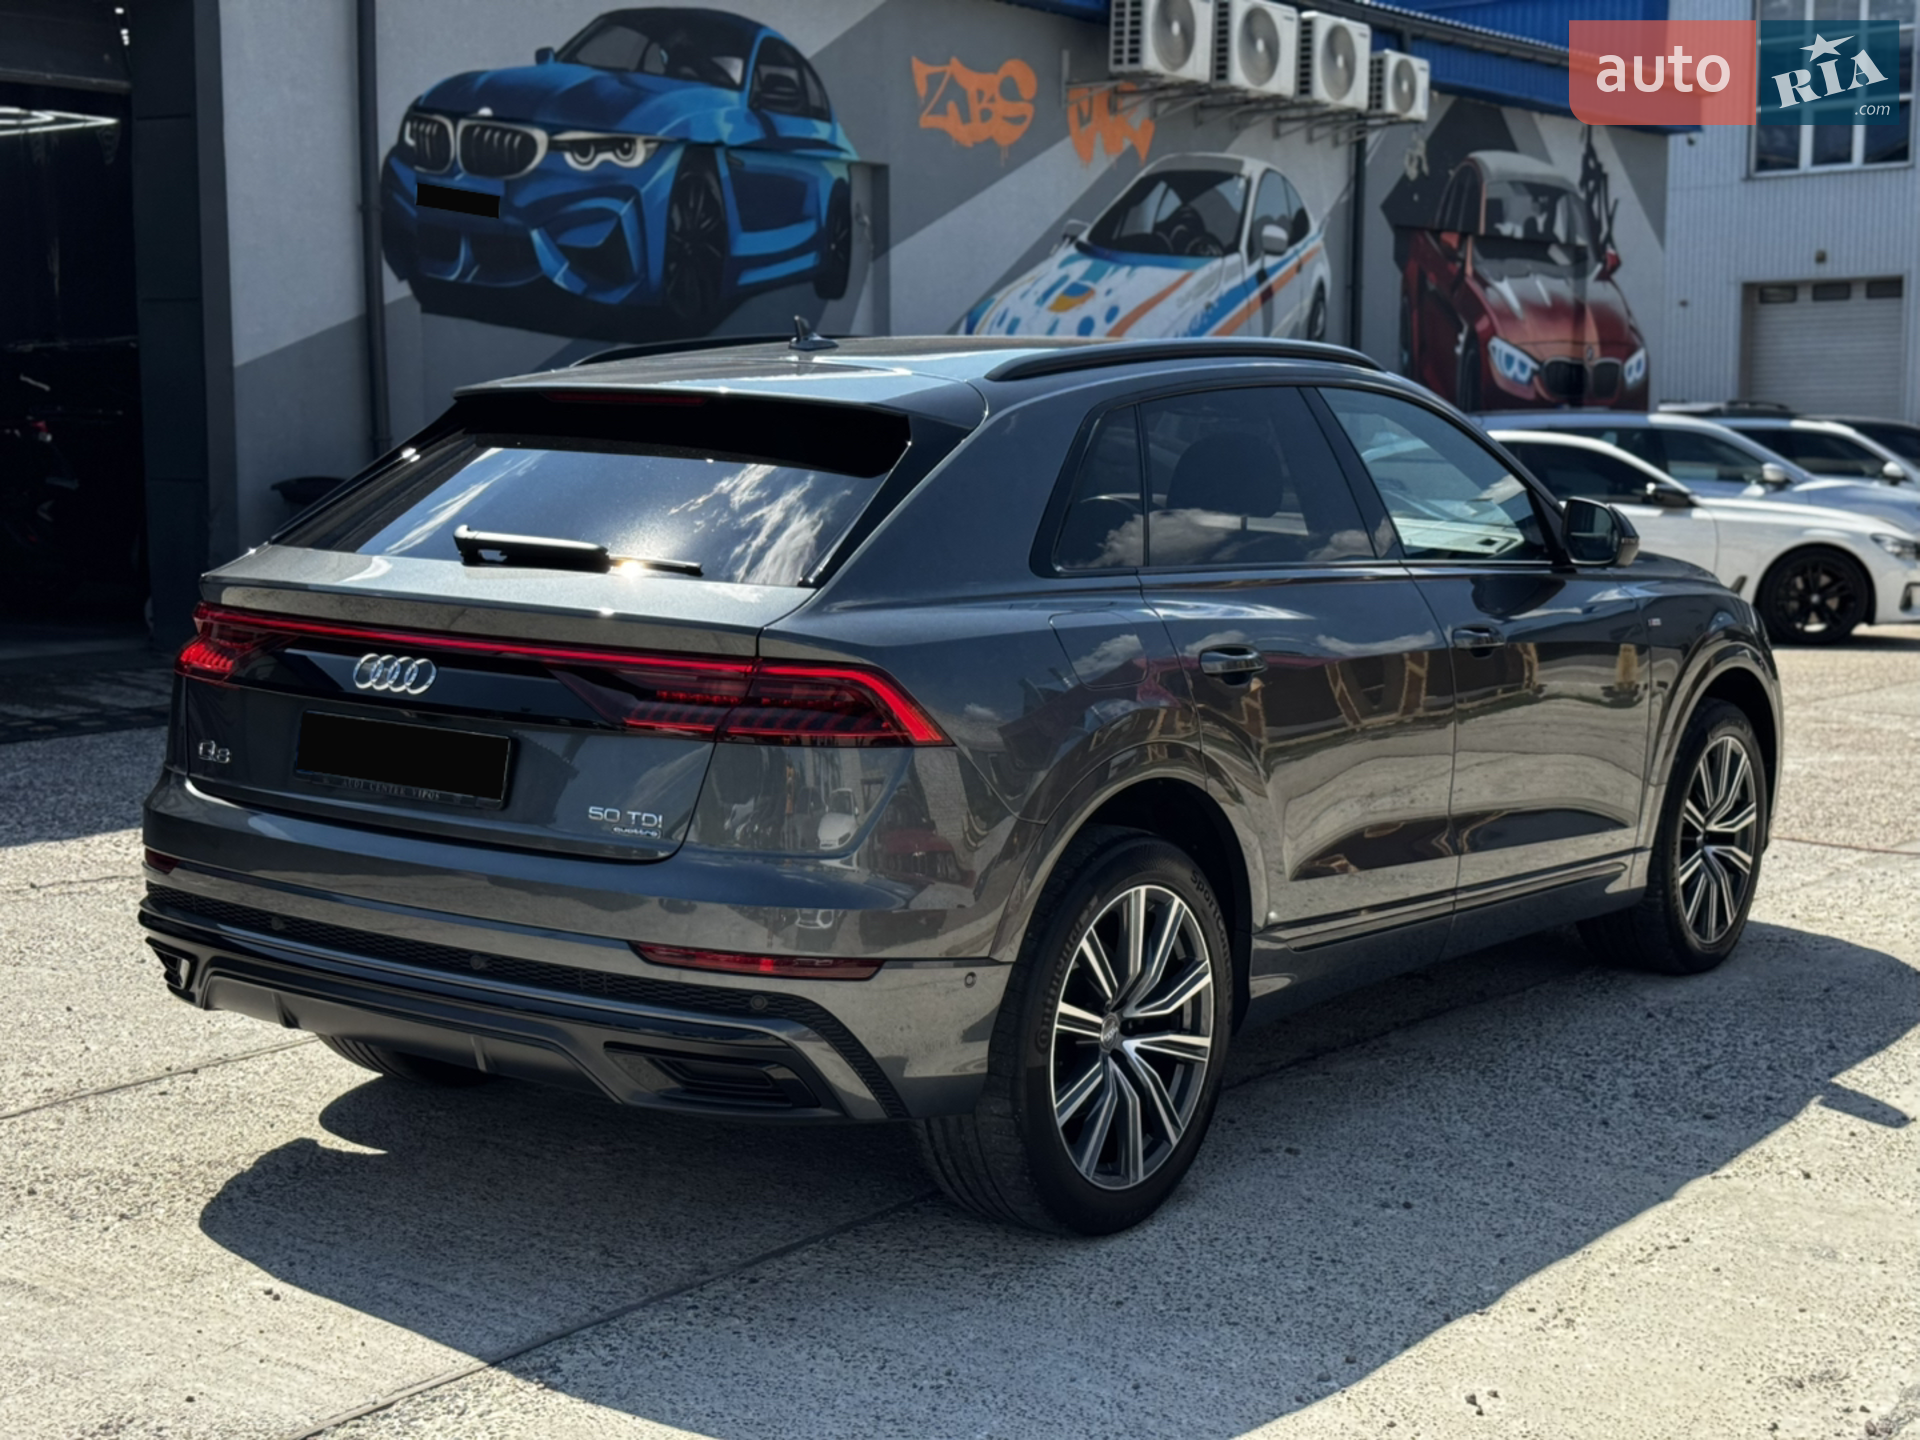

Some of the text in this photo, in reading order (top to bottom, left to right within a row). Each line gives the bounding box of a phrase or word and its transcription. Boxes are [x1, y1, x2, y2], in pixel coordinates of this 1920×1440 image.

[199, 740, 230, 763] Q8
[588, 806, 663, 828] 50 TDI
